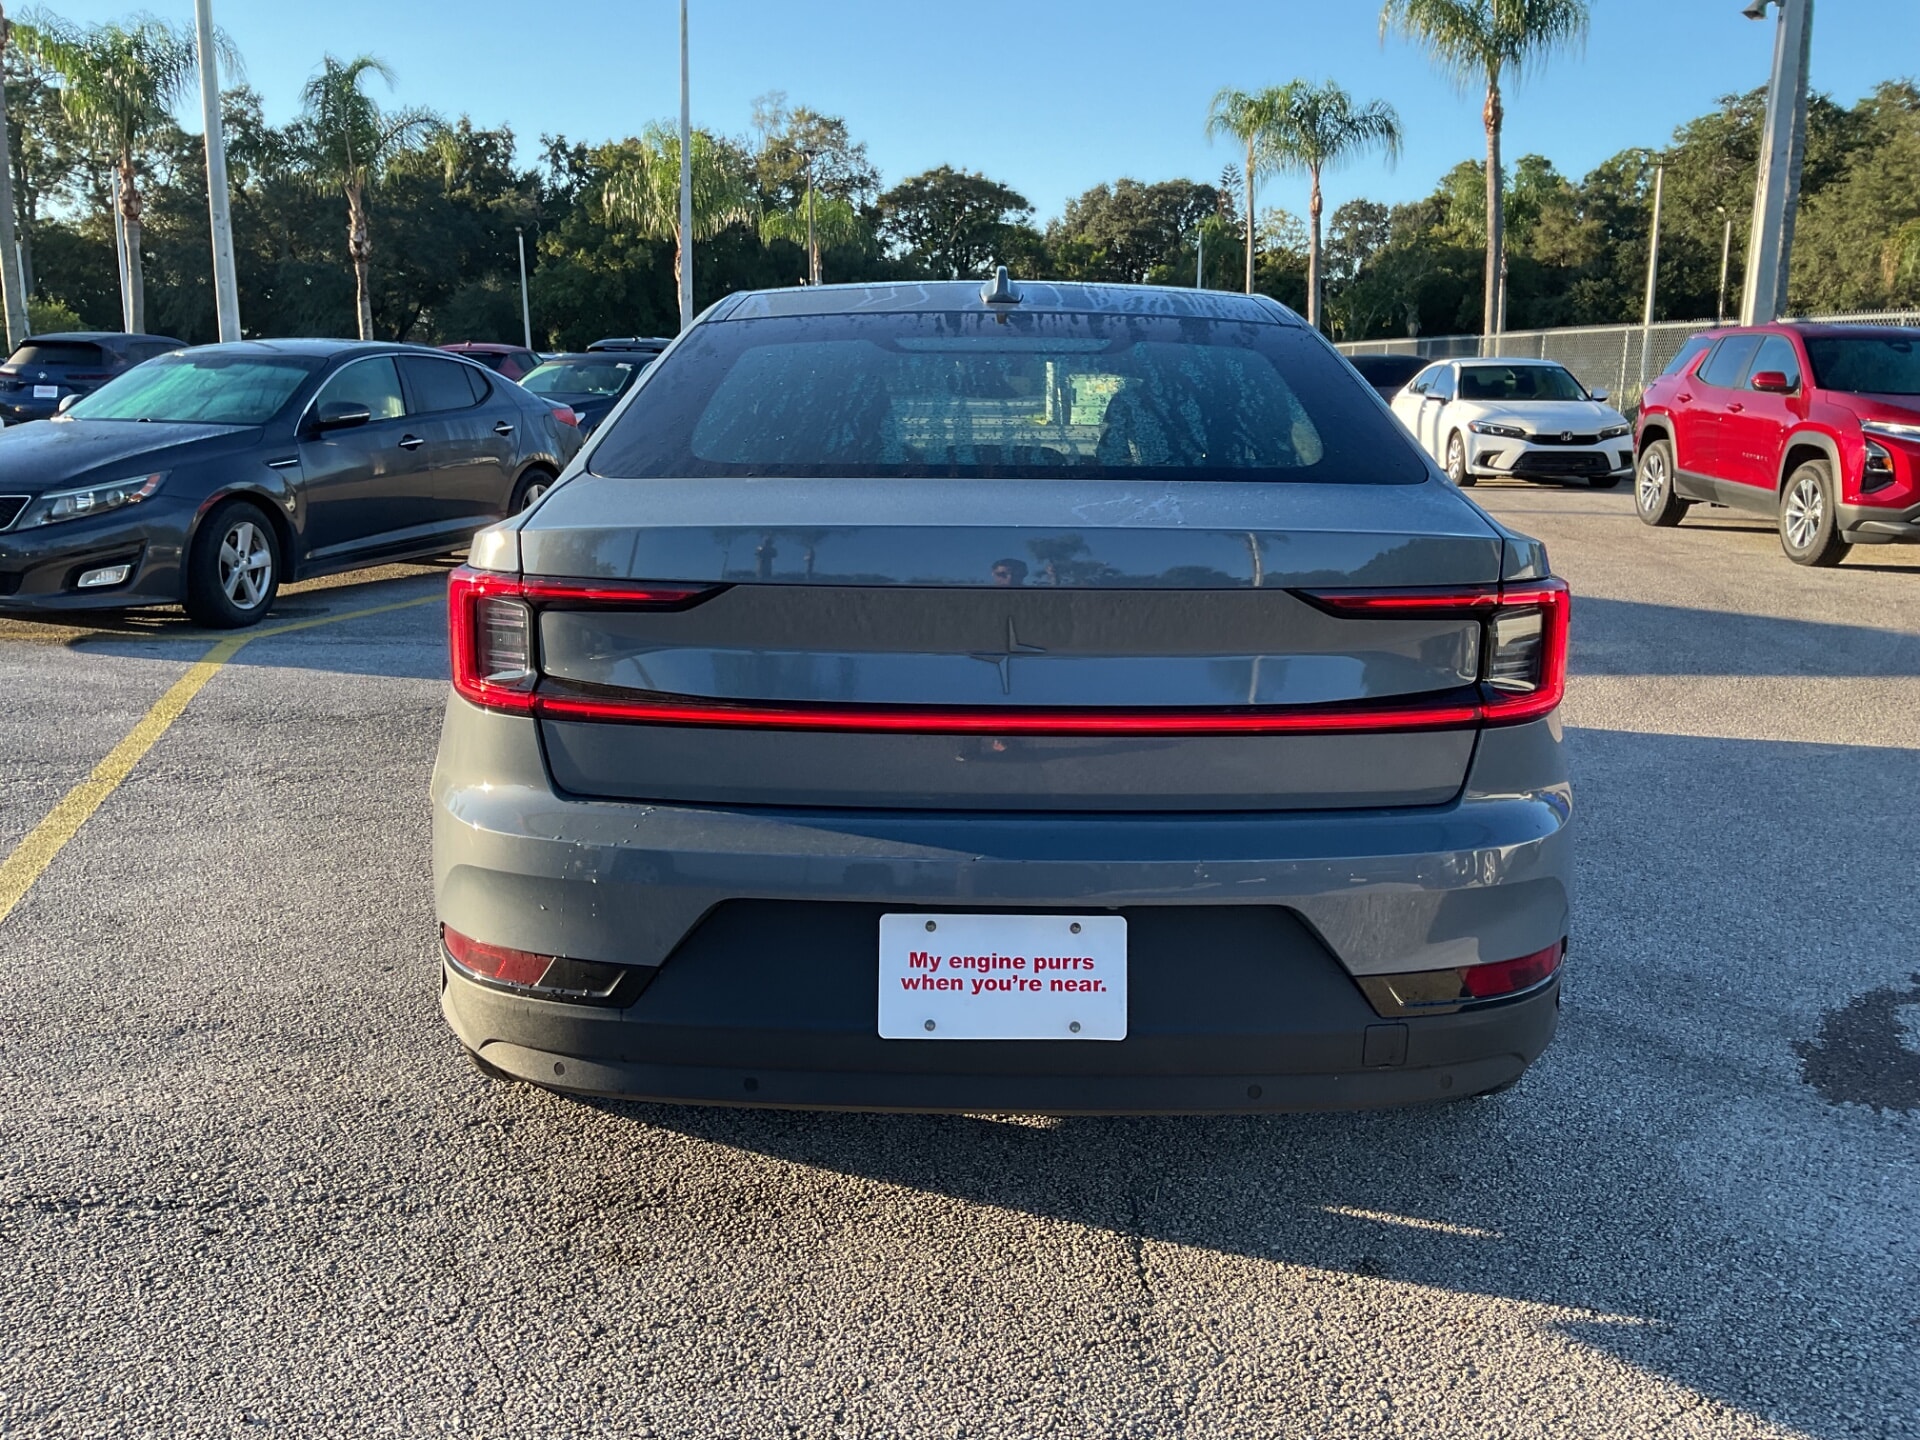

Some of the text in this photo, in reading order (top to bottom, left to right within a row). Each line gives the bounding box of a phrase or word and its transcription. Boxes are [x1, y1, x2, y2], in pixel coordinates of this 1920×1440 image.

[909, 951, 1095, 974] My engine purrs
[900, 974, 1107, 996] when you’re near.
